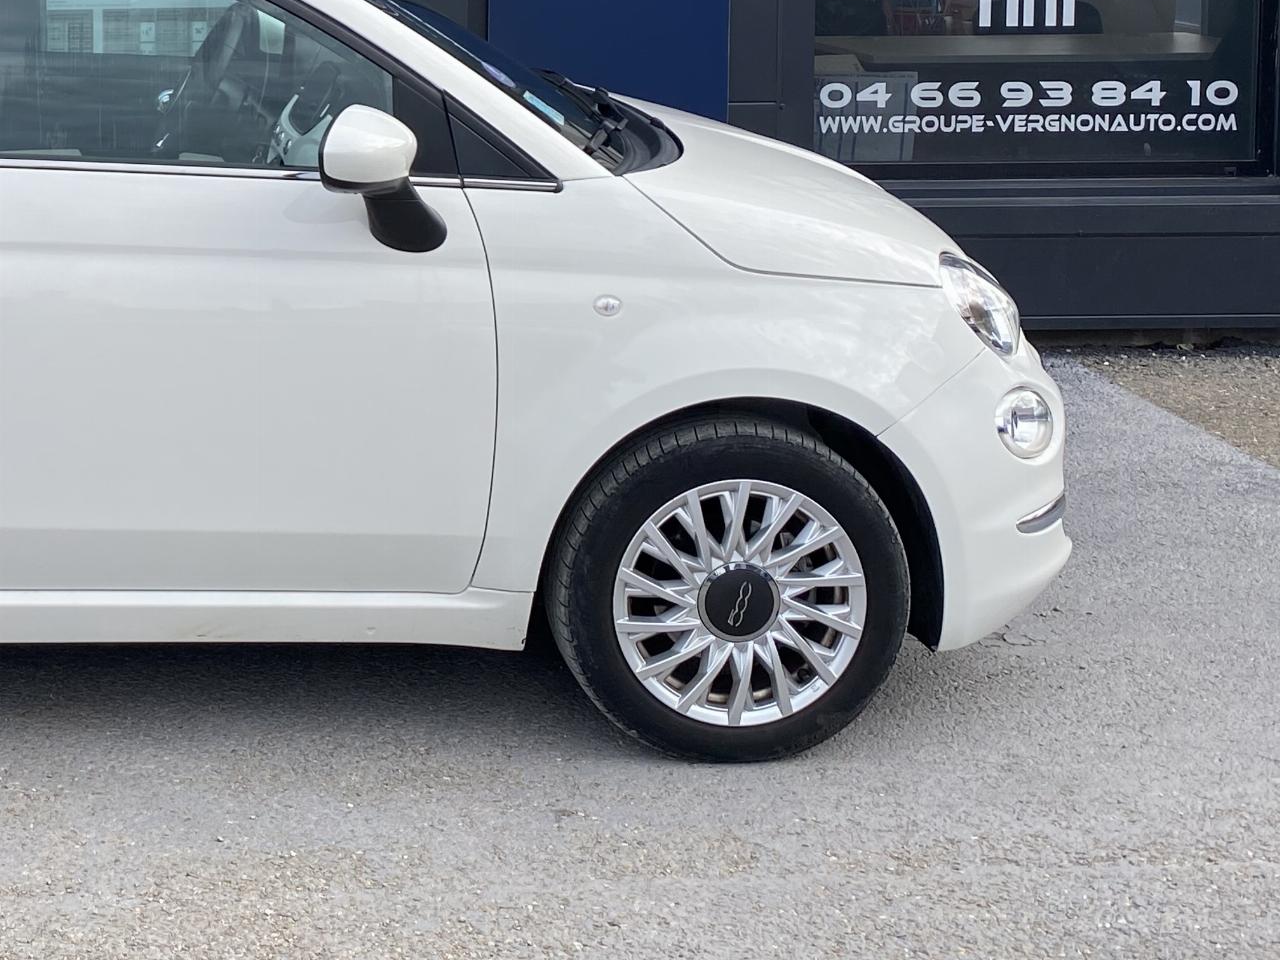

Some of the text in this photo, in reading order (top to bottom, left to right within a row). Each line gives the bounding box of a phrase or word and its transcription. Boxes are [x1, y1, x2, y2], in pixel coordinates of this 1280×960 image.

[819, 80, 1239, 109] 04 66 93 84 10
[819, 113, 1238, 134] WWW.GROUPE-VERGNONAUTO.COM
